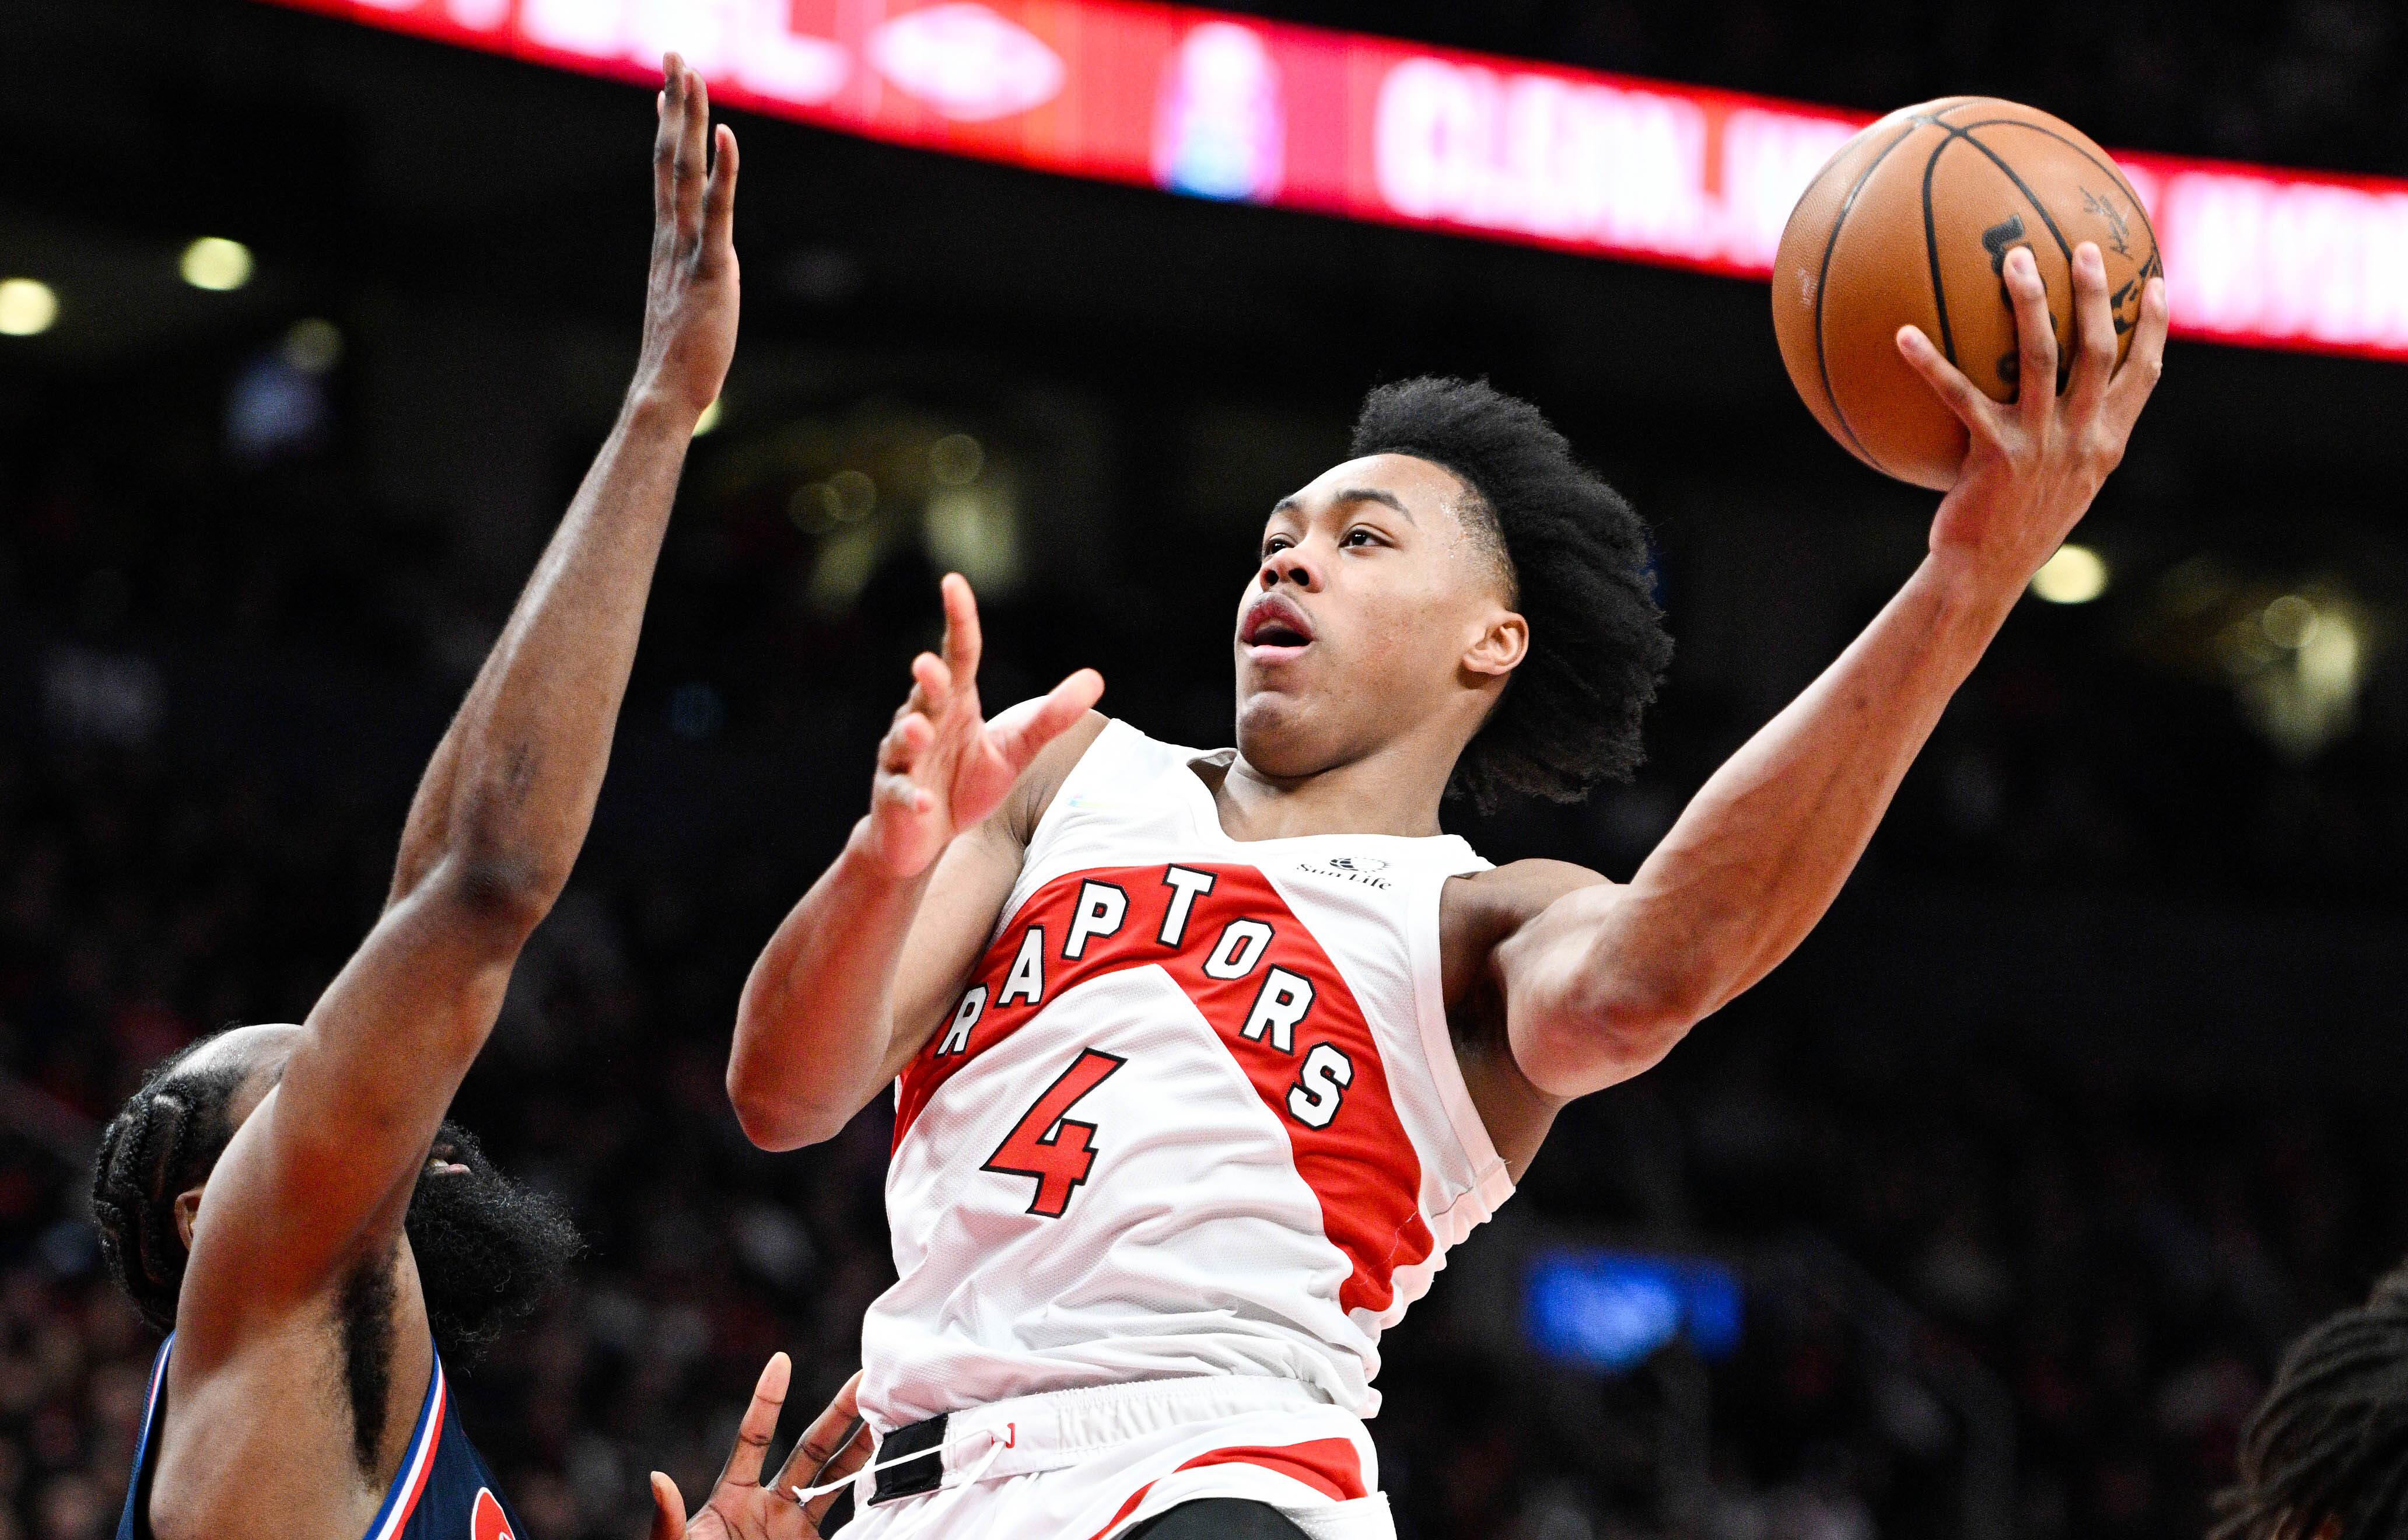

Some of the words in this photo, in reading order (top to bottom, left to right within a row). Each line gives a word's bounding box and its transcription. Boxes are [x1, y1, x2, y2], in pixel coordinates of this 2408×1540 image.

[1296, 863, 1342, 877] Sun
[1349, 874, 1391, 890] Life
[933, 863, 1355, 1130] RAPTORS
[979, 1046, 1129, 1219] 4
